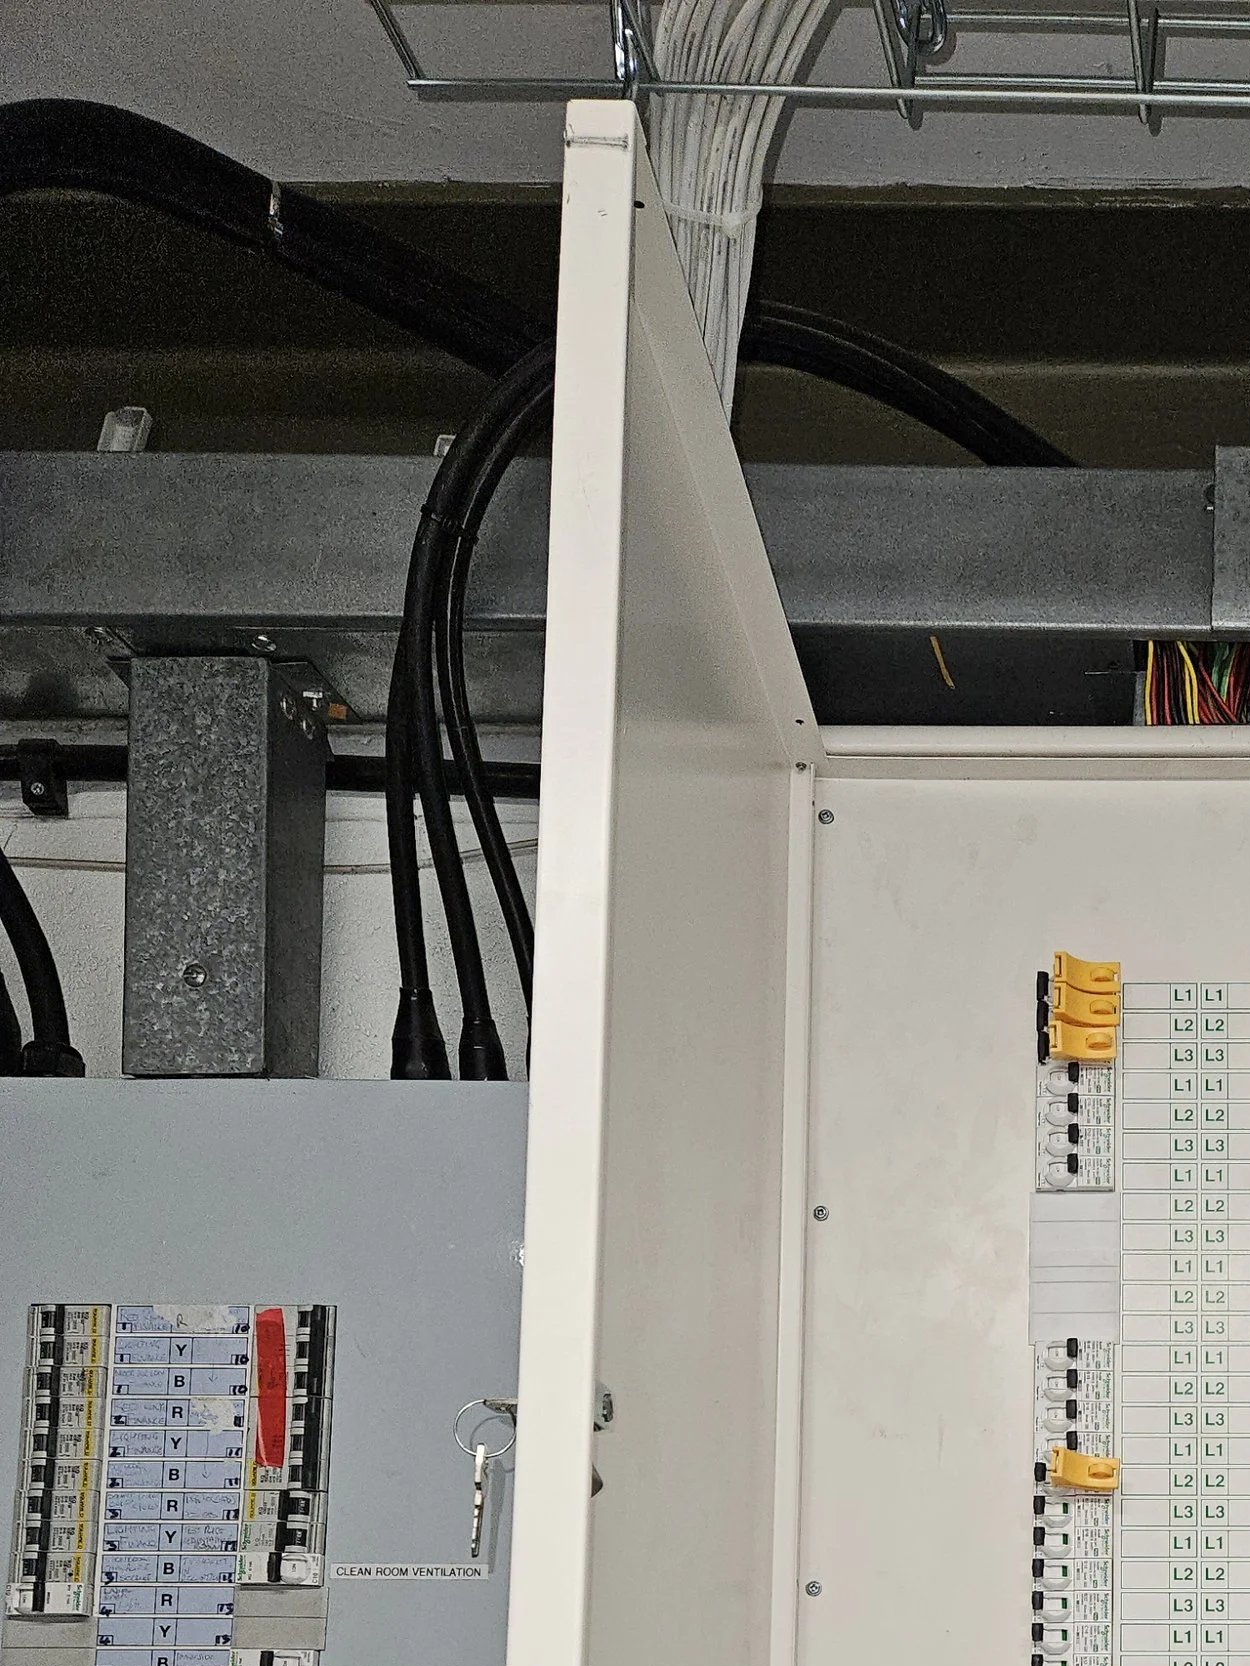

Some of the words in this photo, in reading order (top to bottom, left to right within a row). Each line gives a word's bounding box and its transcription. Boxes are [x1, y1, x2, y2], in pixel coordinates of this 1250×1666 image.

[1174, 988, 1192, 1002] L1
[1204, 988, 1223, 1002] L1
[1174, 1017, 1194, 1032] L2
[1205, 1017, 1225, 1032] L2
[1174, 1048, 1194, 1063] L3
[1205, 1048, 1225, 1062] L3
[1174, 1078, 1192, 1093] L1
[1205, 1078, 1223, 1092] L1
[1174, 1108, 1194, 1122] L2
[1205, 1108, 1225, 1122] L2
[1174, 1138, 1194, 1153] L3
[1205, 1138, 1225, 1153] L3
[1174, 1168, 1192, 1183] L1
[1205, 1168, 1223, 1183] L1
[1174, 1198, 1195, 1213] L2
[1205, 1198, 1225, 1213] L2
[1174, 1228, 1194, 1244] L3
[1205, 1229, 1225, 1244] L3
[1174, 1259, 1192, 1274] L1
[1205, 1259, 1223, 1274] L1
[1174, 1289, 1194, 1304] L2
[1205, 1290, 1226, 1304] L2
[1174, 1320, 1194, 1335] L3
[1205, 1320, 1225, 1335] L3
[176, 1344, 187, 1356] Y
[1174, 1350, 1192, 1365] L1
[1205, 1350, 1223, 1365] L1
[175, 1376, 185, 1387] B
[1173, 1381, 1194, 1396] L2
[1205, 1381, 1225, 1396] L2
[172, 1407, 183, 1418] R
[1173, 1411, 1194, 1427] L3
[1205, 1411, 1225, 1427] L3
[171, 1438, 181, 1449] Y
[1173, 1442, 1192, 1457] L1
[1205, 1442, 1223, 1457] L1
[169, 1469, 179, 1481] B
[1173, 1473, 1194, 1488] L2
[1205, 1473, 1226, 1488] L2
[167, 1500, 178, 1512] R
[1173, 1504, 1194, 1519] L3
[1205, 1504, 1225, 1519] L3
[165, 1531, 176, 1543] Y
[1173, 1535, 1192, 1550] L1
[1205, 1535, 1223, 1550] L1
[164, 1563, 174, 1574] B
[336, 1567, 371, 1576] CLEAN
[376, 1567, 408, 1576] ROOM
[412, 1567, 481, 1577] VENTILATION
[1173, 1566, 1194, 1581] L2
[1205, 1566, 1226, 1581] L2
[162, 1594, 172, 1606] R
[1173, 1598, 1194, 1613] L3
[1205, 1598, 1225, 1613] L3
[160, 1626, 171, 1637] Y
[1173, 1629, 1192, 1644] L1
[1205, 1629, 1223, 1644] L1
